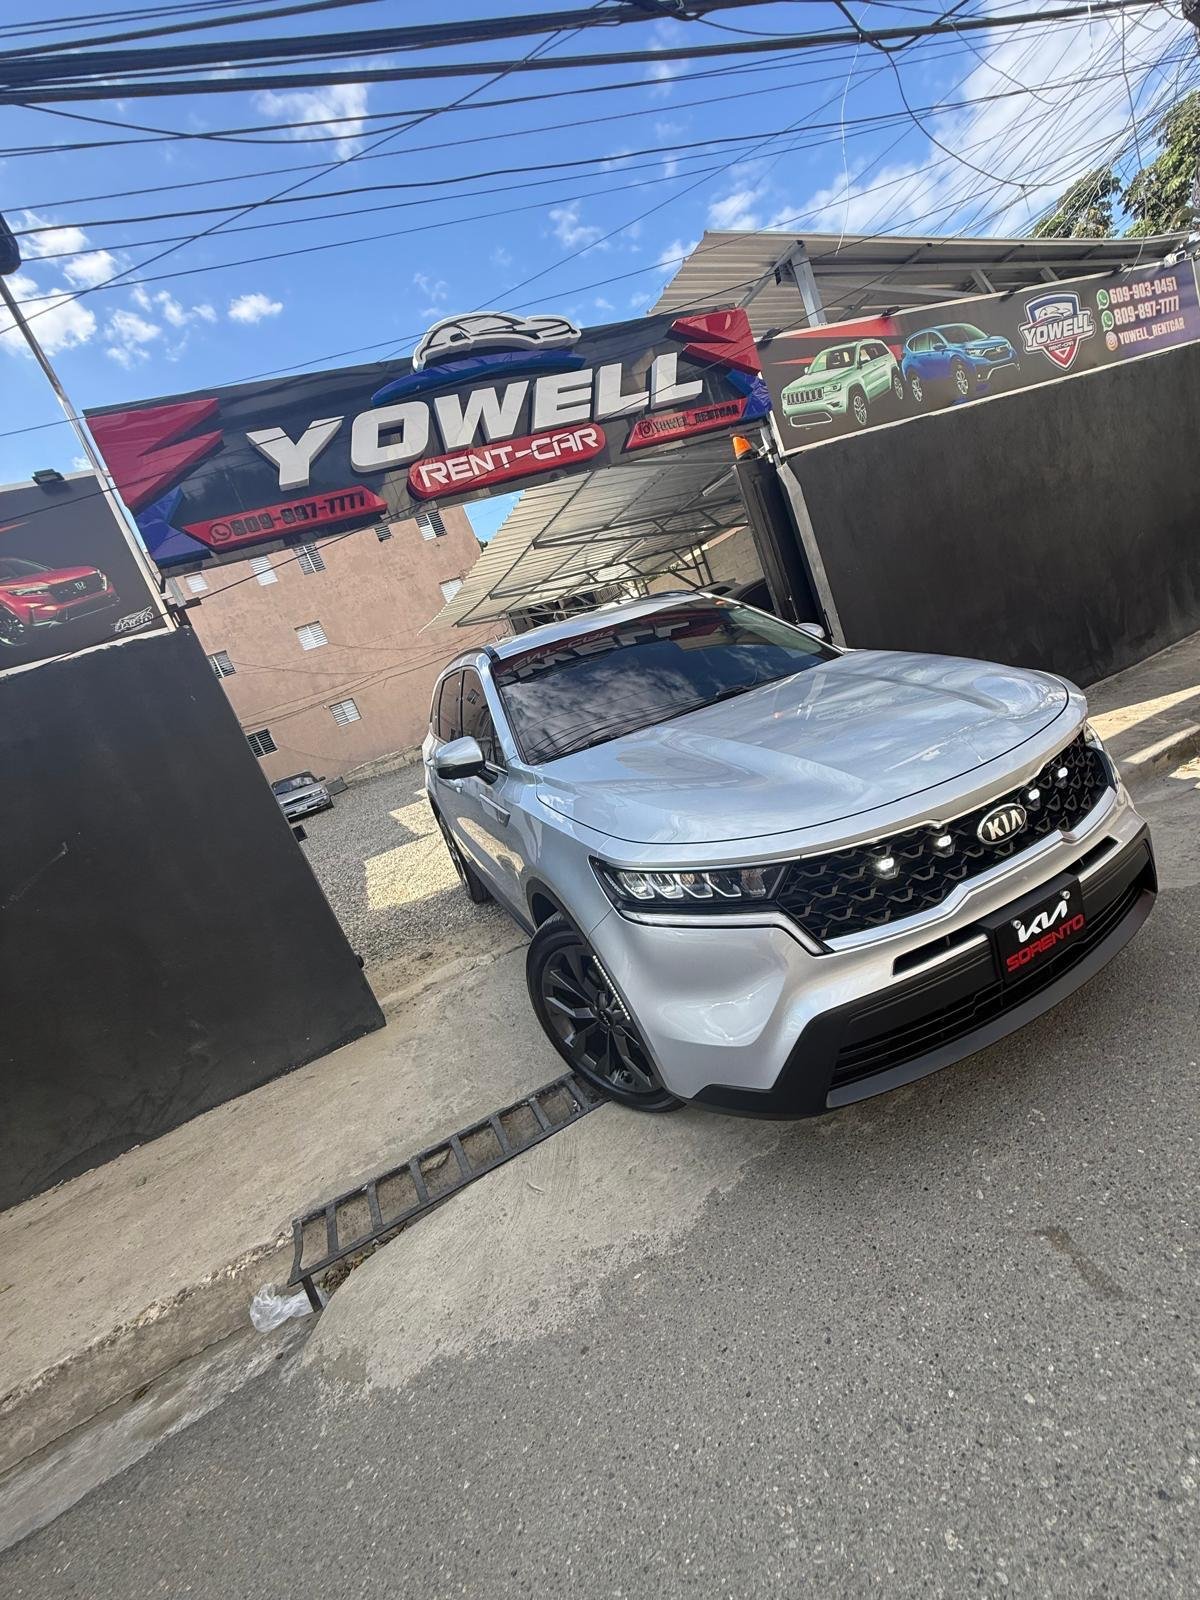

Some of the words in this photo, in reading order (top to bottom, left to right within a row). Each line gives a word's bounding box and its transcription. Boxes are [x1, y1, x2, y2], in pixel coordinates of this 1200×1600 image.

[1113, 295, 1180, 325] 809-897-7777
[1023, 314, 1094, 347] YOWELL
[1118, 317, 1185, 345] YOWELL_RENTCAR
[245, 352, 703, 491] YOWELL
[418, 427, 598, 488] RENT-CAR
[230, 491, 366, 537] 809-897-7777
[986, 809, 1023, 840] KIA
[1006, 913, 1086, 972] SORENTO
